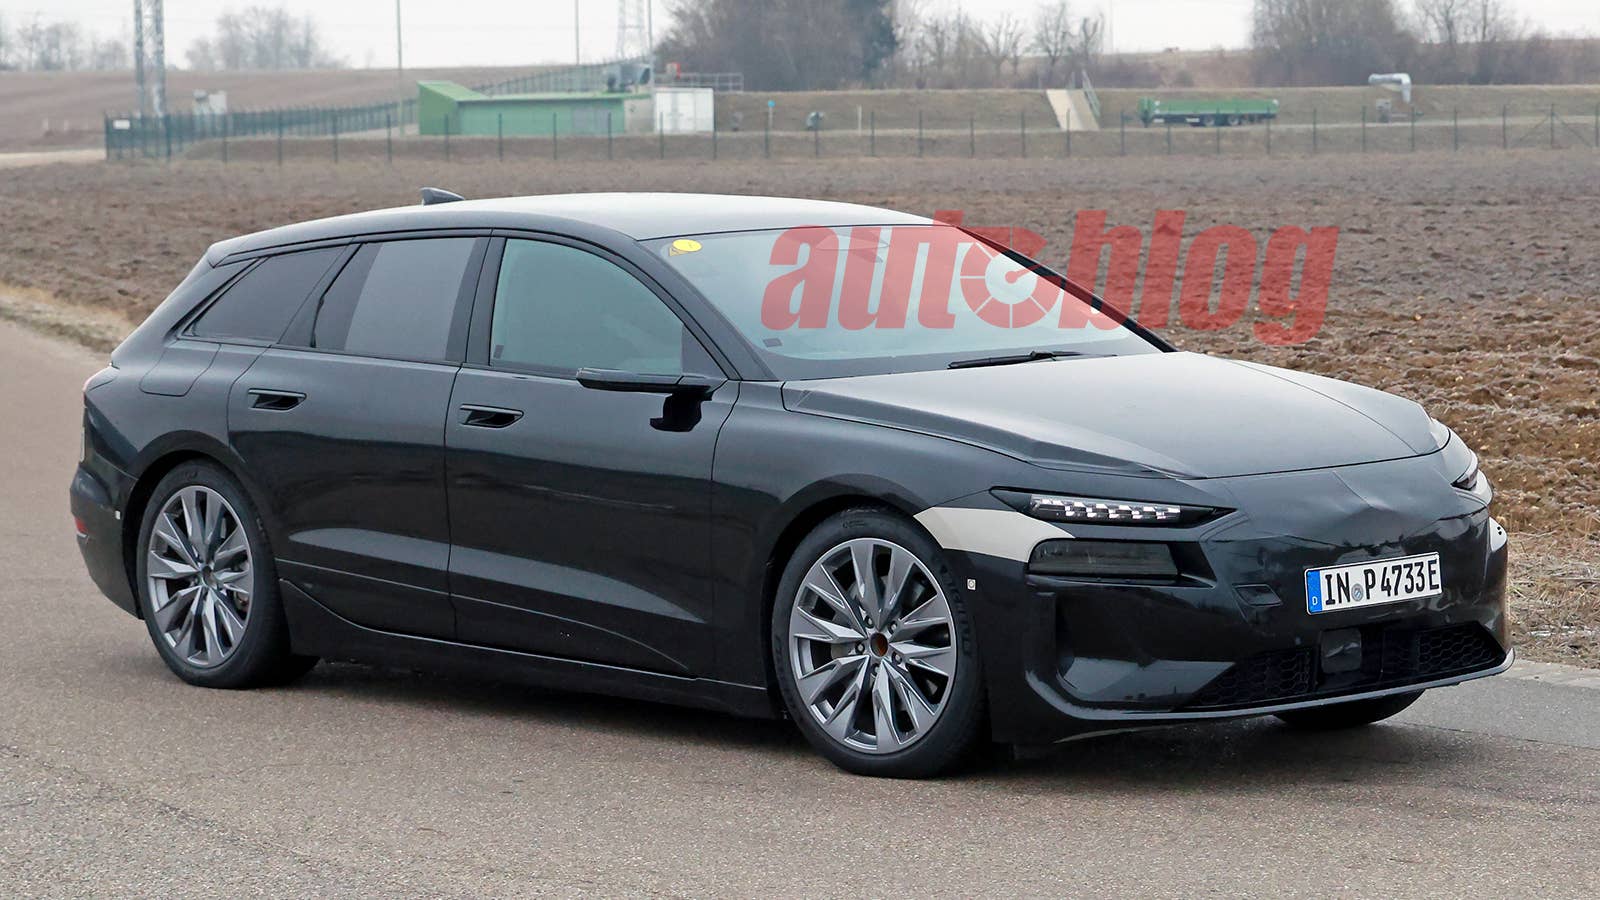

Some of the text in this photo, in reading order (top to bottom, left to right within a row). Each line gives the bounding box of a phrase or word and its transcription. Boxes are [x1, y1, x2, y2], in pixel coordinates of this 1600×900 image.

[1324, 559, 1440, 605] IN P 4733E
